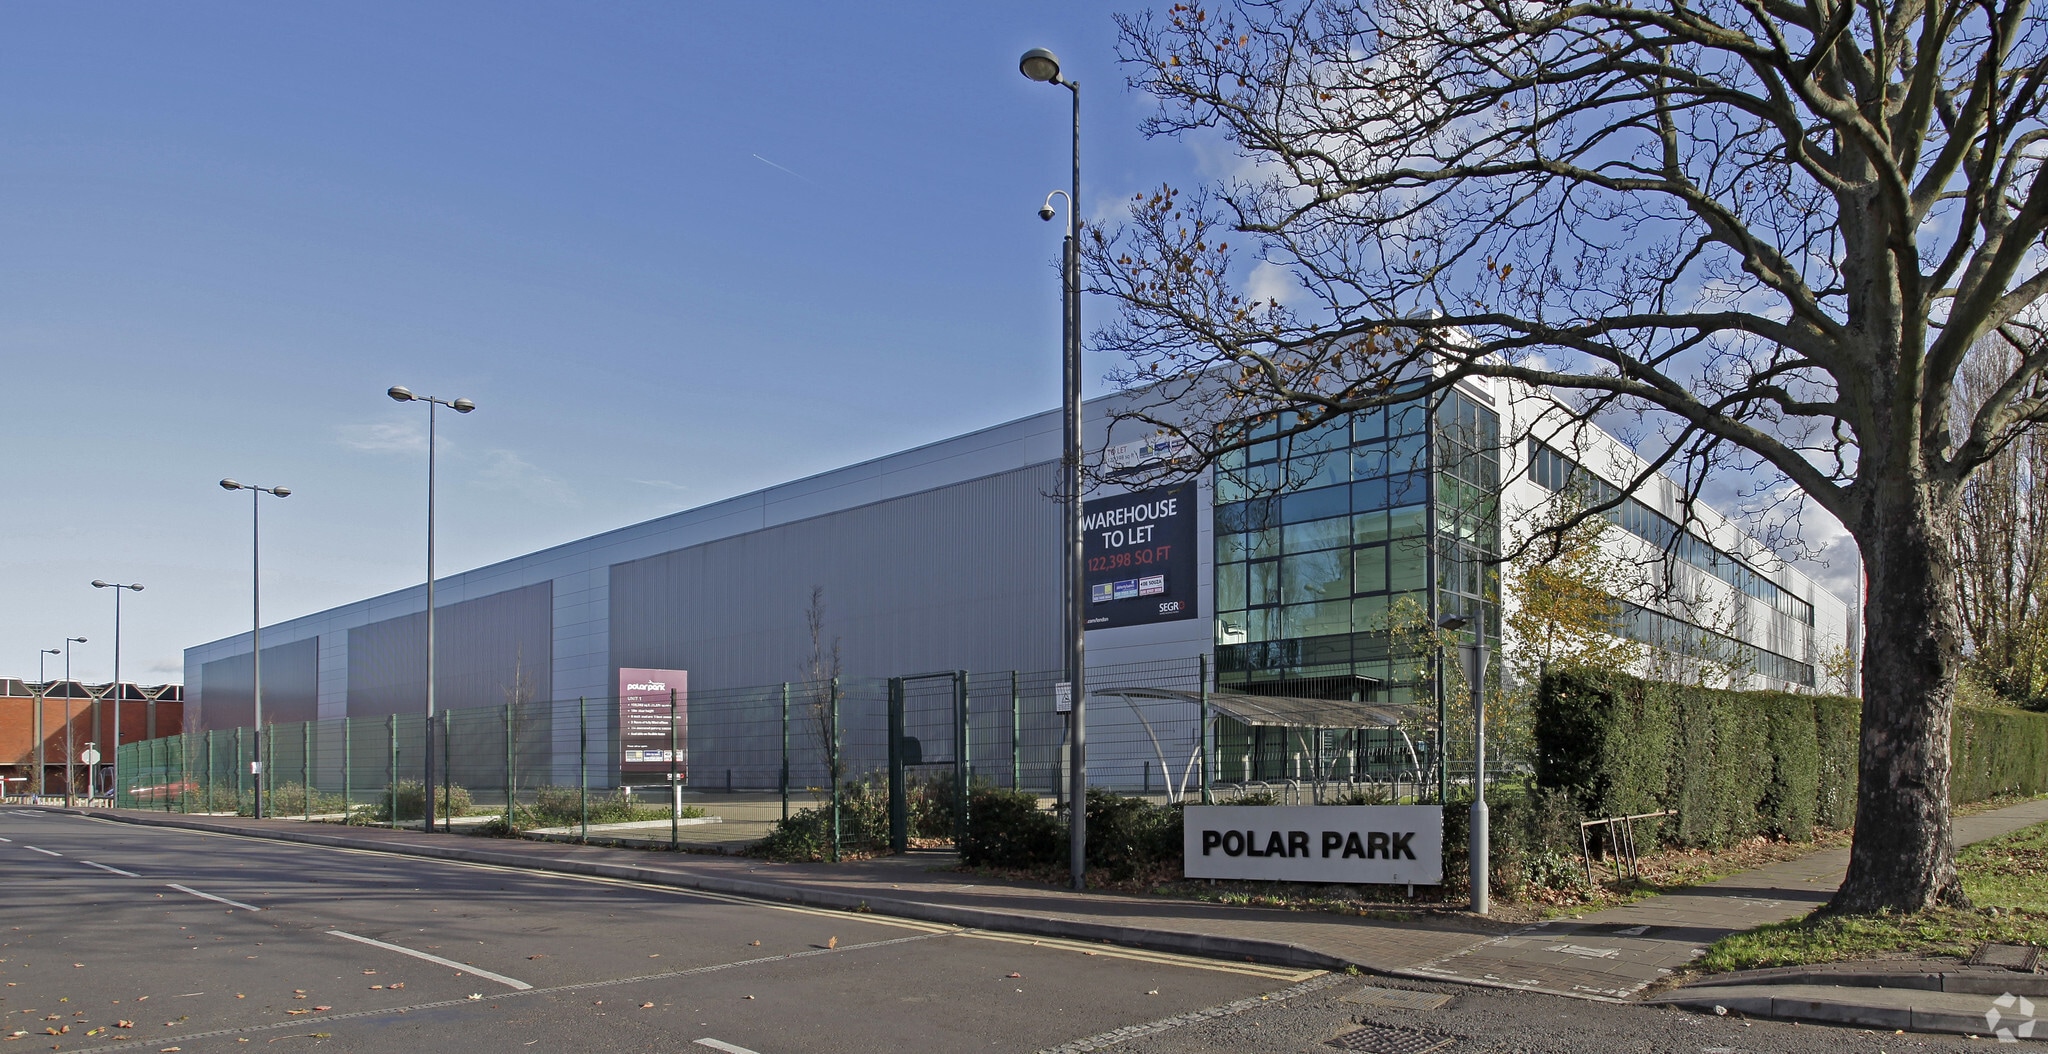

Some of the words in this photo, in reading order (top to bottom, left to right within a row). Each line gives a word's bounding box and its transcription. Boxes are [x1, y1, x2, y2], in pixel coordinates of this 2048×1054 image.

[1117, 445, 1127, 454] LET
[1082, 498, 1177, 532] WAREHOUSE
[1102, 530, 1124, 549] TO
[1128, 524, 1155, 545] LET
[1088, 552, 1131, 572] 122,398
[1135, 549, 1153, 565] SQ
[1156, 545, 1171, 561] FT
[1159, 600, 1185, 613] SEGRO
[1202, 829, 1310, 858] POLAR
[1321, 830, 1417, 861] PARK
